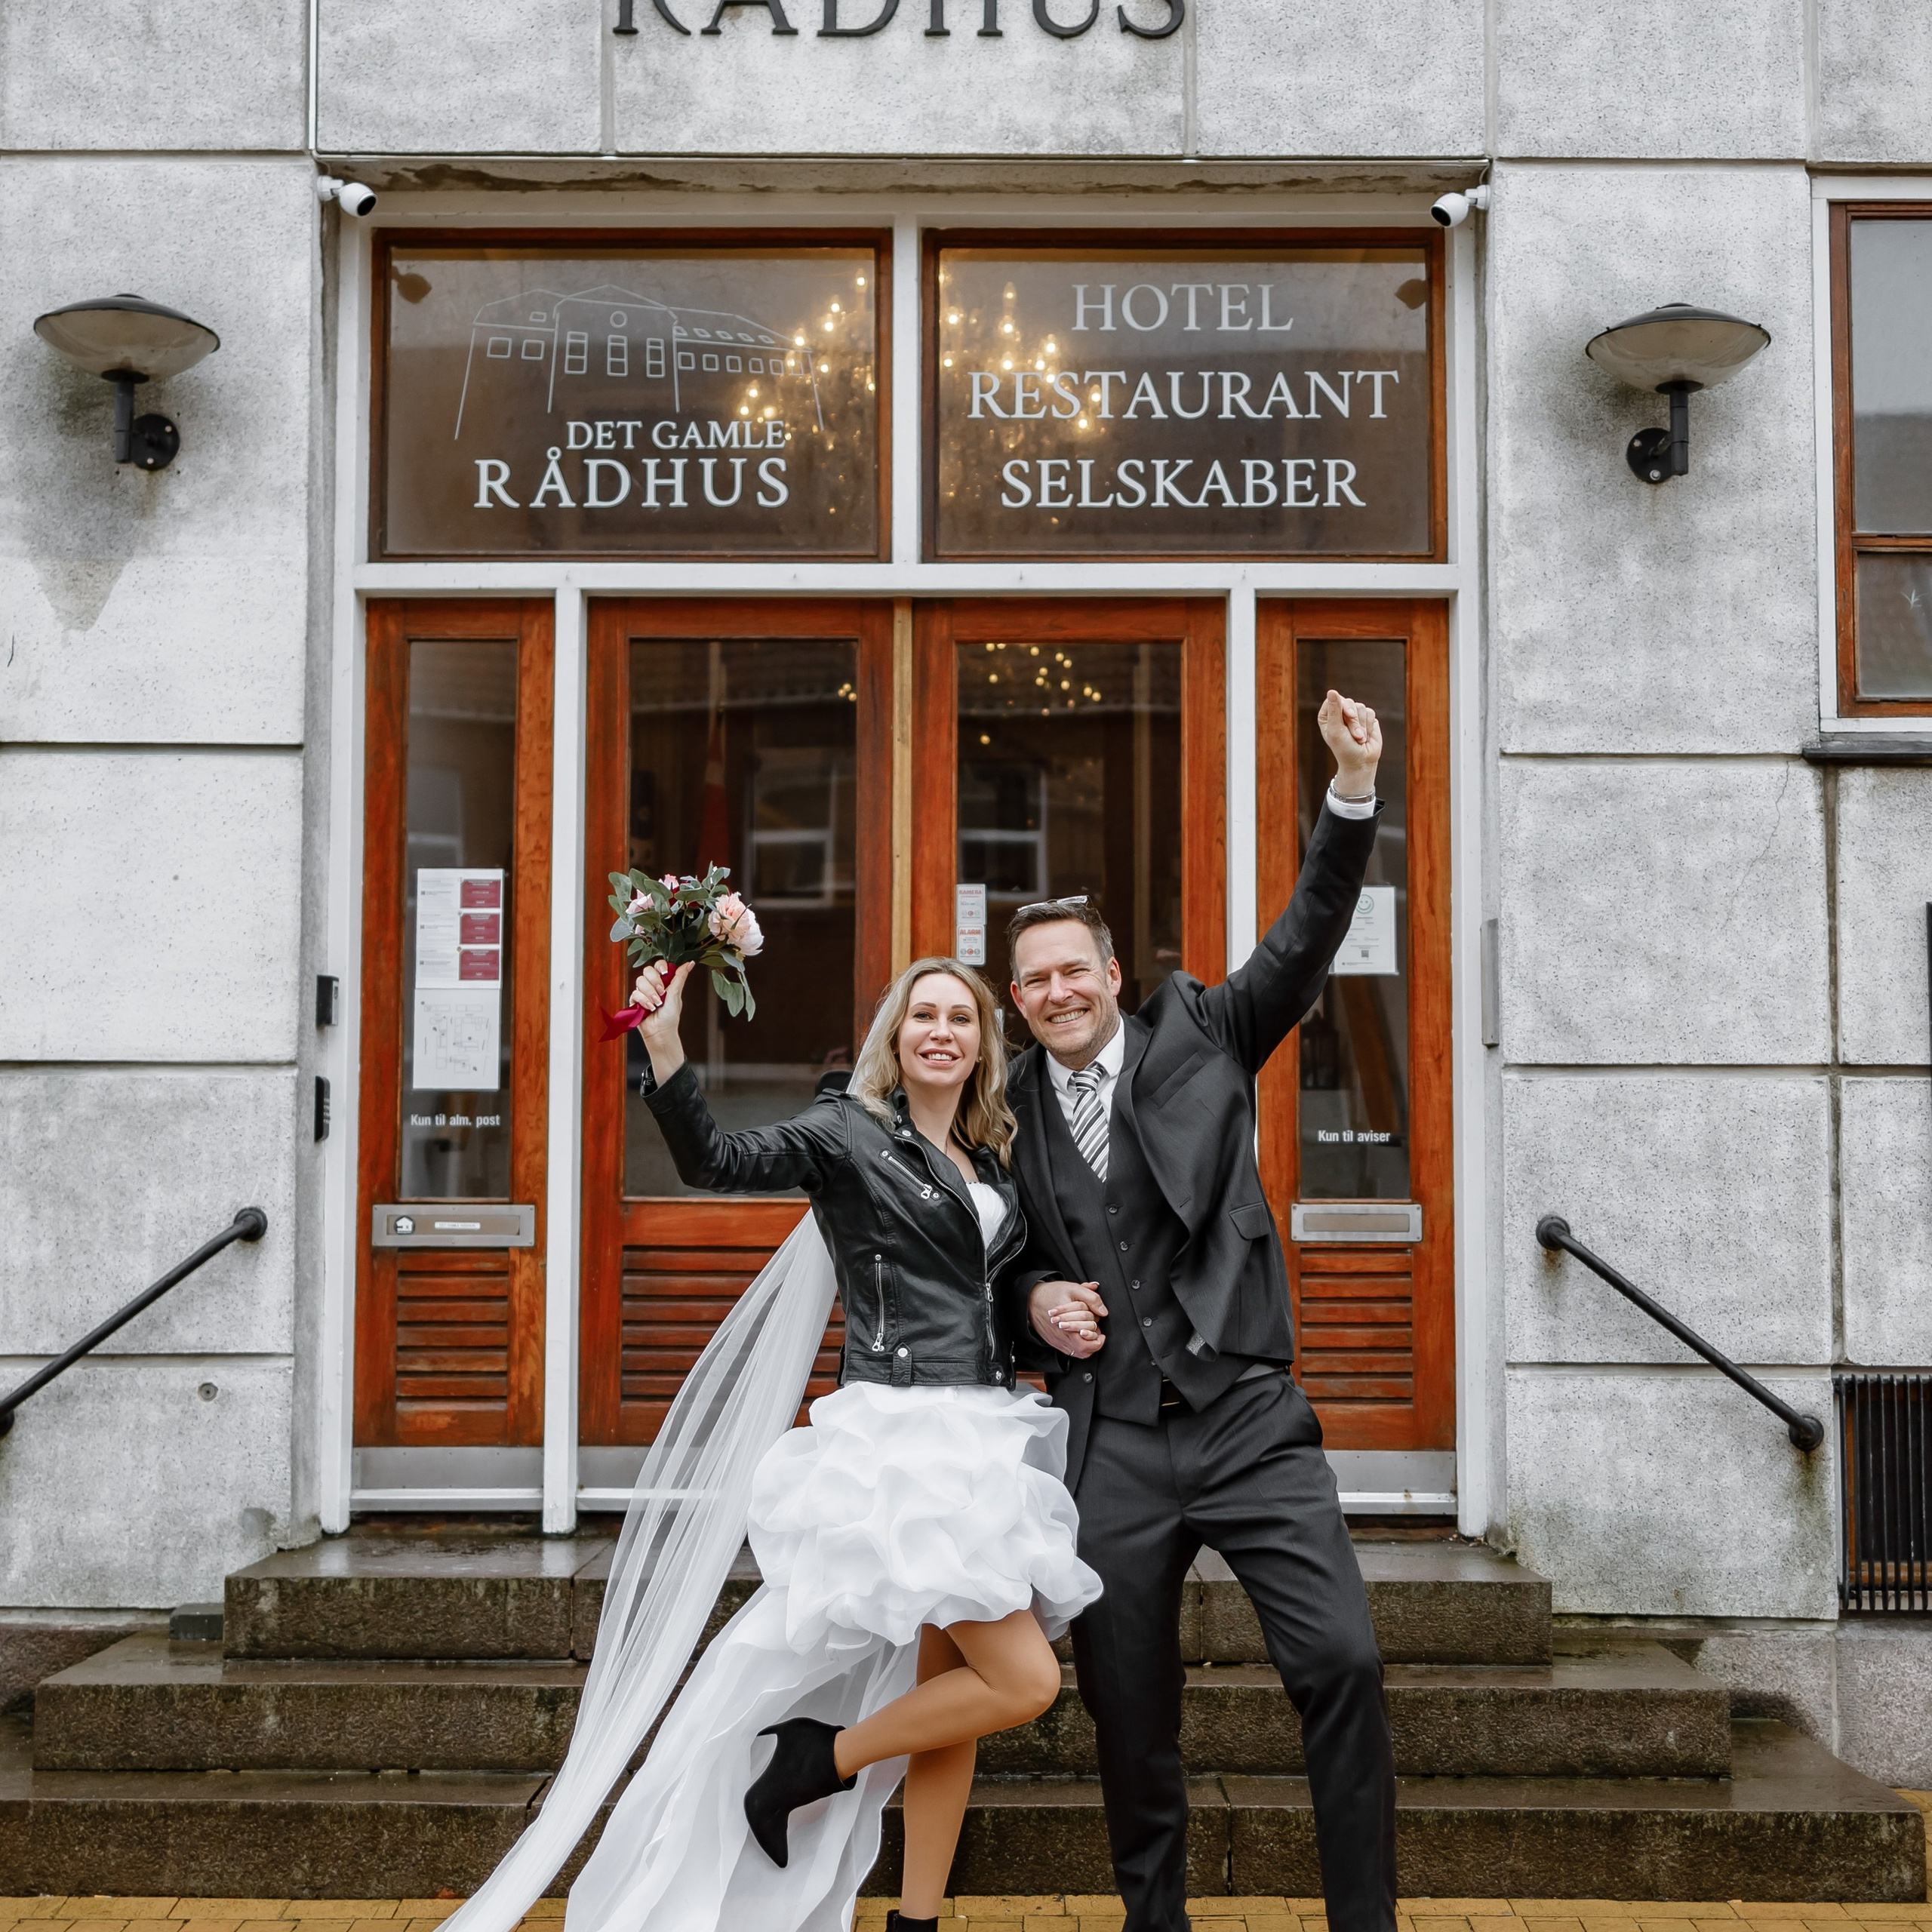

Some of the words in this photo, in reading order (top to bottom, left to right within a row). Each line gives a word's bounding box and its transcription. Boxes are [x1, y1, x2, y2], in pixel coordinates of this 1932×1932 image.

[1072, 284, 1294, 331] HOTEL
[967, 370, 1399, 419] RESTAURANT
[566, 421, 641, 449] DET
[652, 421, 786, 449] GAMLE
[473, 446, 789, 509] RÅDHUS
[1001, 459, 1367, 509] SELSKABER
[411, 1114, 431, 1126] Kun
[435, 1113, 445, 1126] til
[449, 1114, 472, 1126] alm.
[476, 1114, 500, 1128] post
[1318, 1130, 1340, 1142] Kun
[1343, 1130, 1354, 1142] til
[1357, 1130, 1391, 1143] aviser
